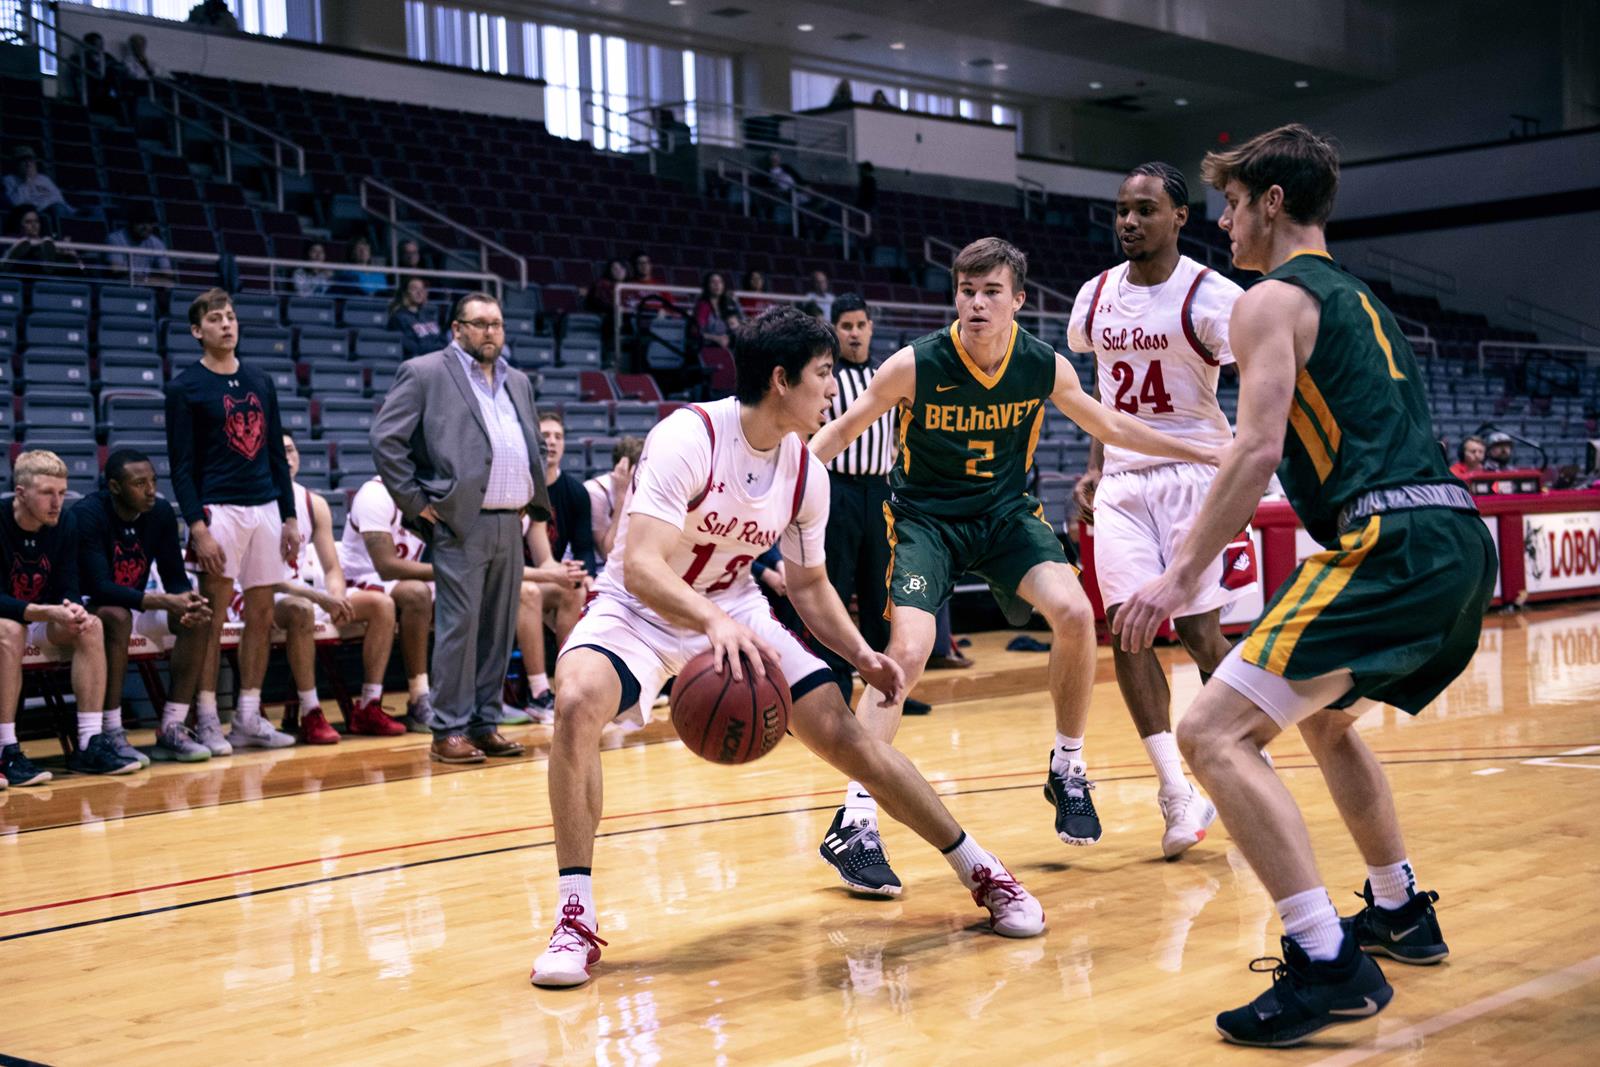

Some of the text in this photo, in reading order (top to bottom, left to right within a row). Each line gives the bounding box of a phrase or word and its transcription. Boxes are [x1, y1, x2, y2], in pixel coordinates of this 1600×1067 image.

[1102, 327, 1168, 351] Sul Ross
[1111, 359, 1174, 414] 24
[965, 439, 995, 478] 2
[697, 511, 738, 537] Sul
[1548, 528, 1600, 578] LOBO
